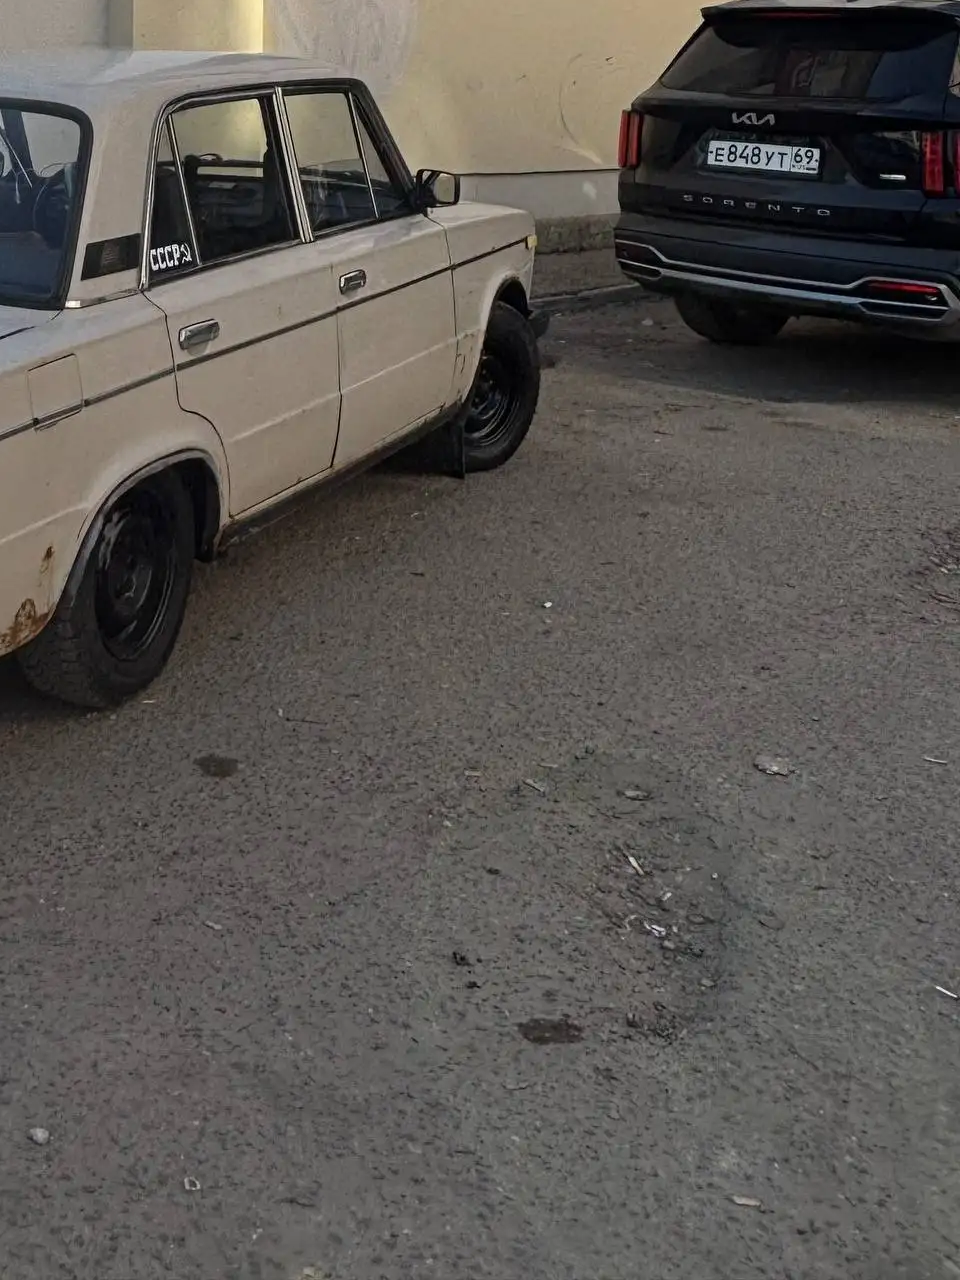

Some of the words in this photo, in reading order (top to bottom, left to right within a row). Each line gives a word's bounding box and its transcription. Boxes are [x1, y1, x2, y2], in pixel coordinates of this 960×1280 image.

[731, 112, 776, 125] KIA
[714, 144, 788, 168] Е848УТ
[793, 148, 814, 164] 69
[683, 194, 831, 216] SORENTO
[149, 243, 181, 271] СССР
